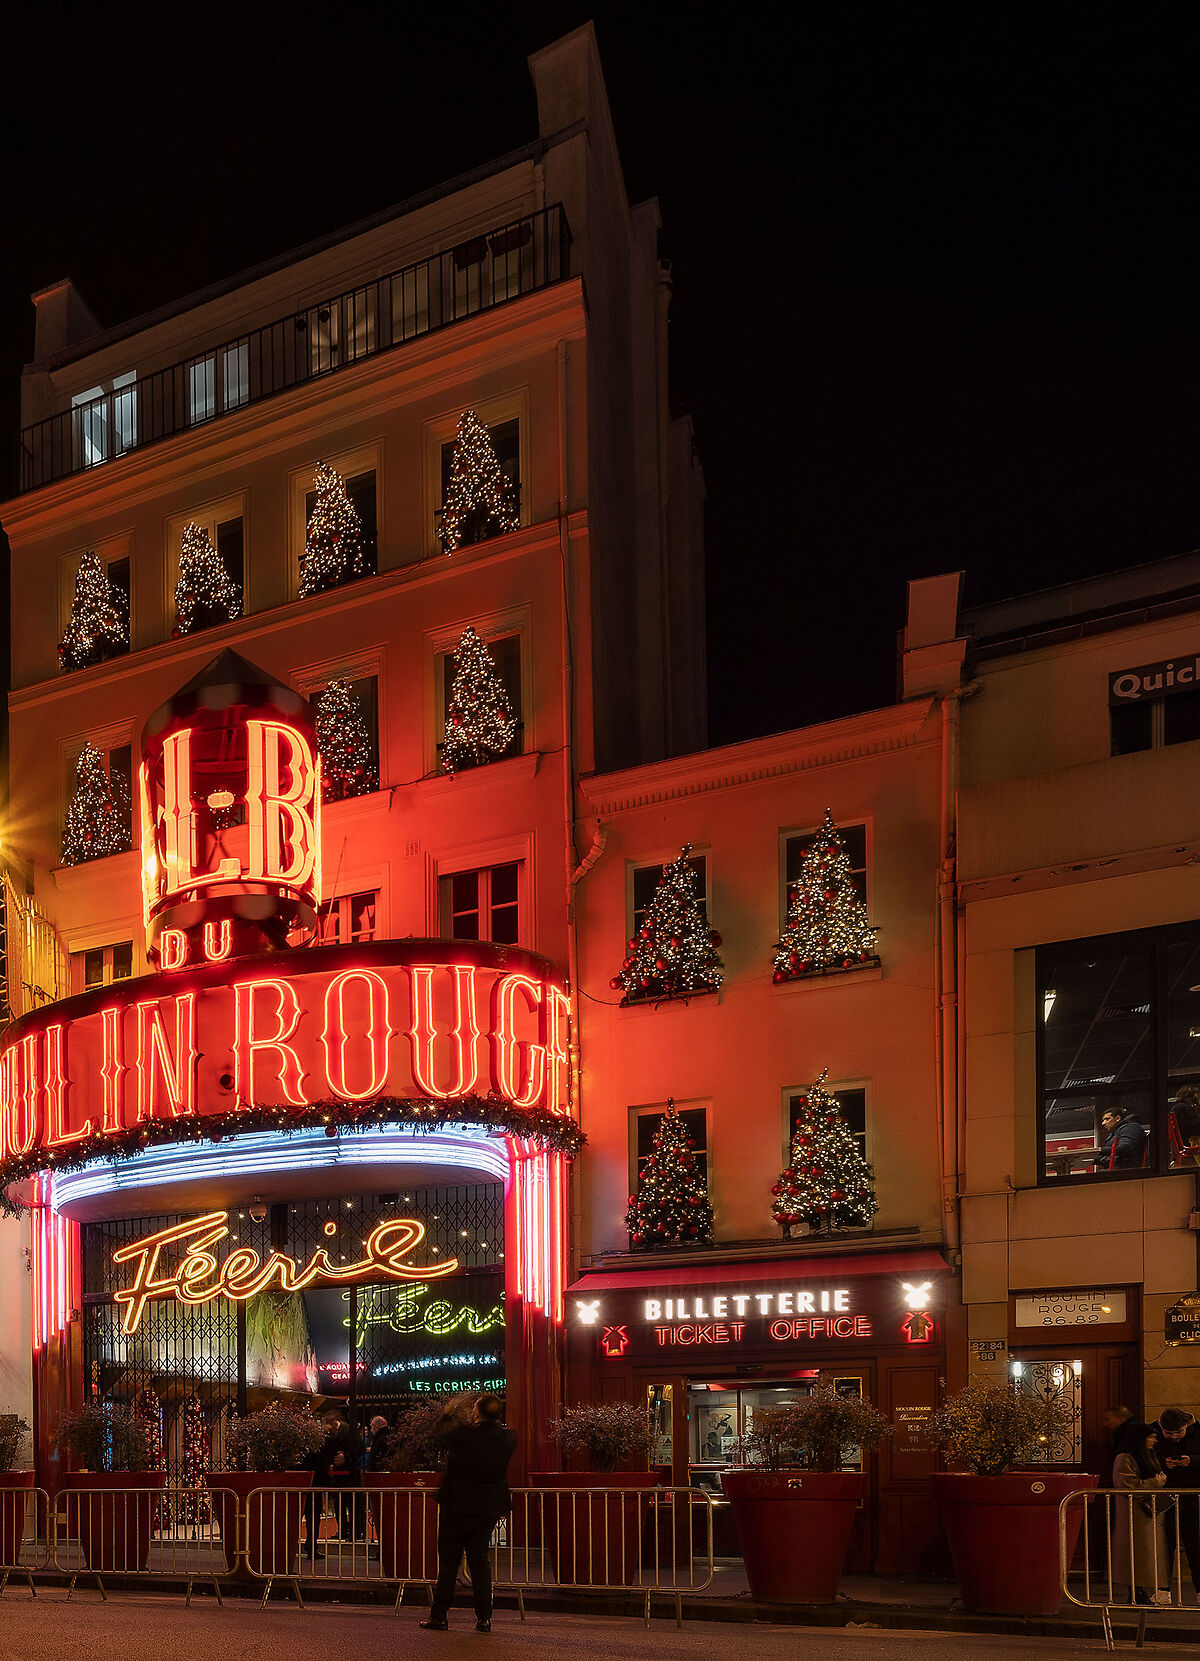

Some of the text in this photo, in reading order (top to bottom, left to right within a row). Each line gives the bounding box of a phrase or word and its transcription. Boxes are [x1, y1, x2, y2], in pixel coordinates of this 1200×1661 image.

[160, 919, 231, 970] DU
[113, 1211, 459, 1335] Féerie
[1031, 1292, 1106, 1303] MOULIN
[644, 1289, 849, 1321] BILLETTERIE
[1038, 1303, 1102, 1314] ROUGE
[1171, 1313, 1200, 1323] BOULE
[654, 1315, 872, 1345] TICKET OFFICE
[1179, 1330, 1200, 1339] CLIC
[409, 1380, 431, 1392] LES
